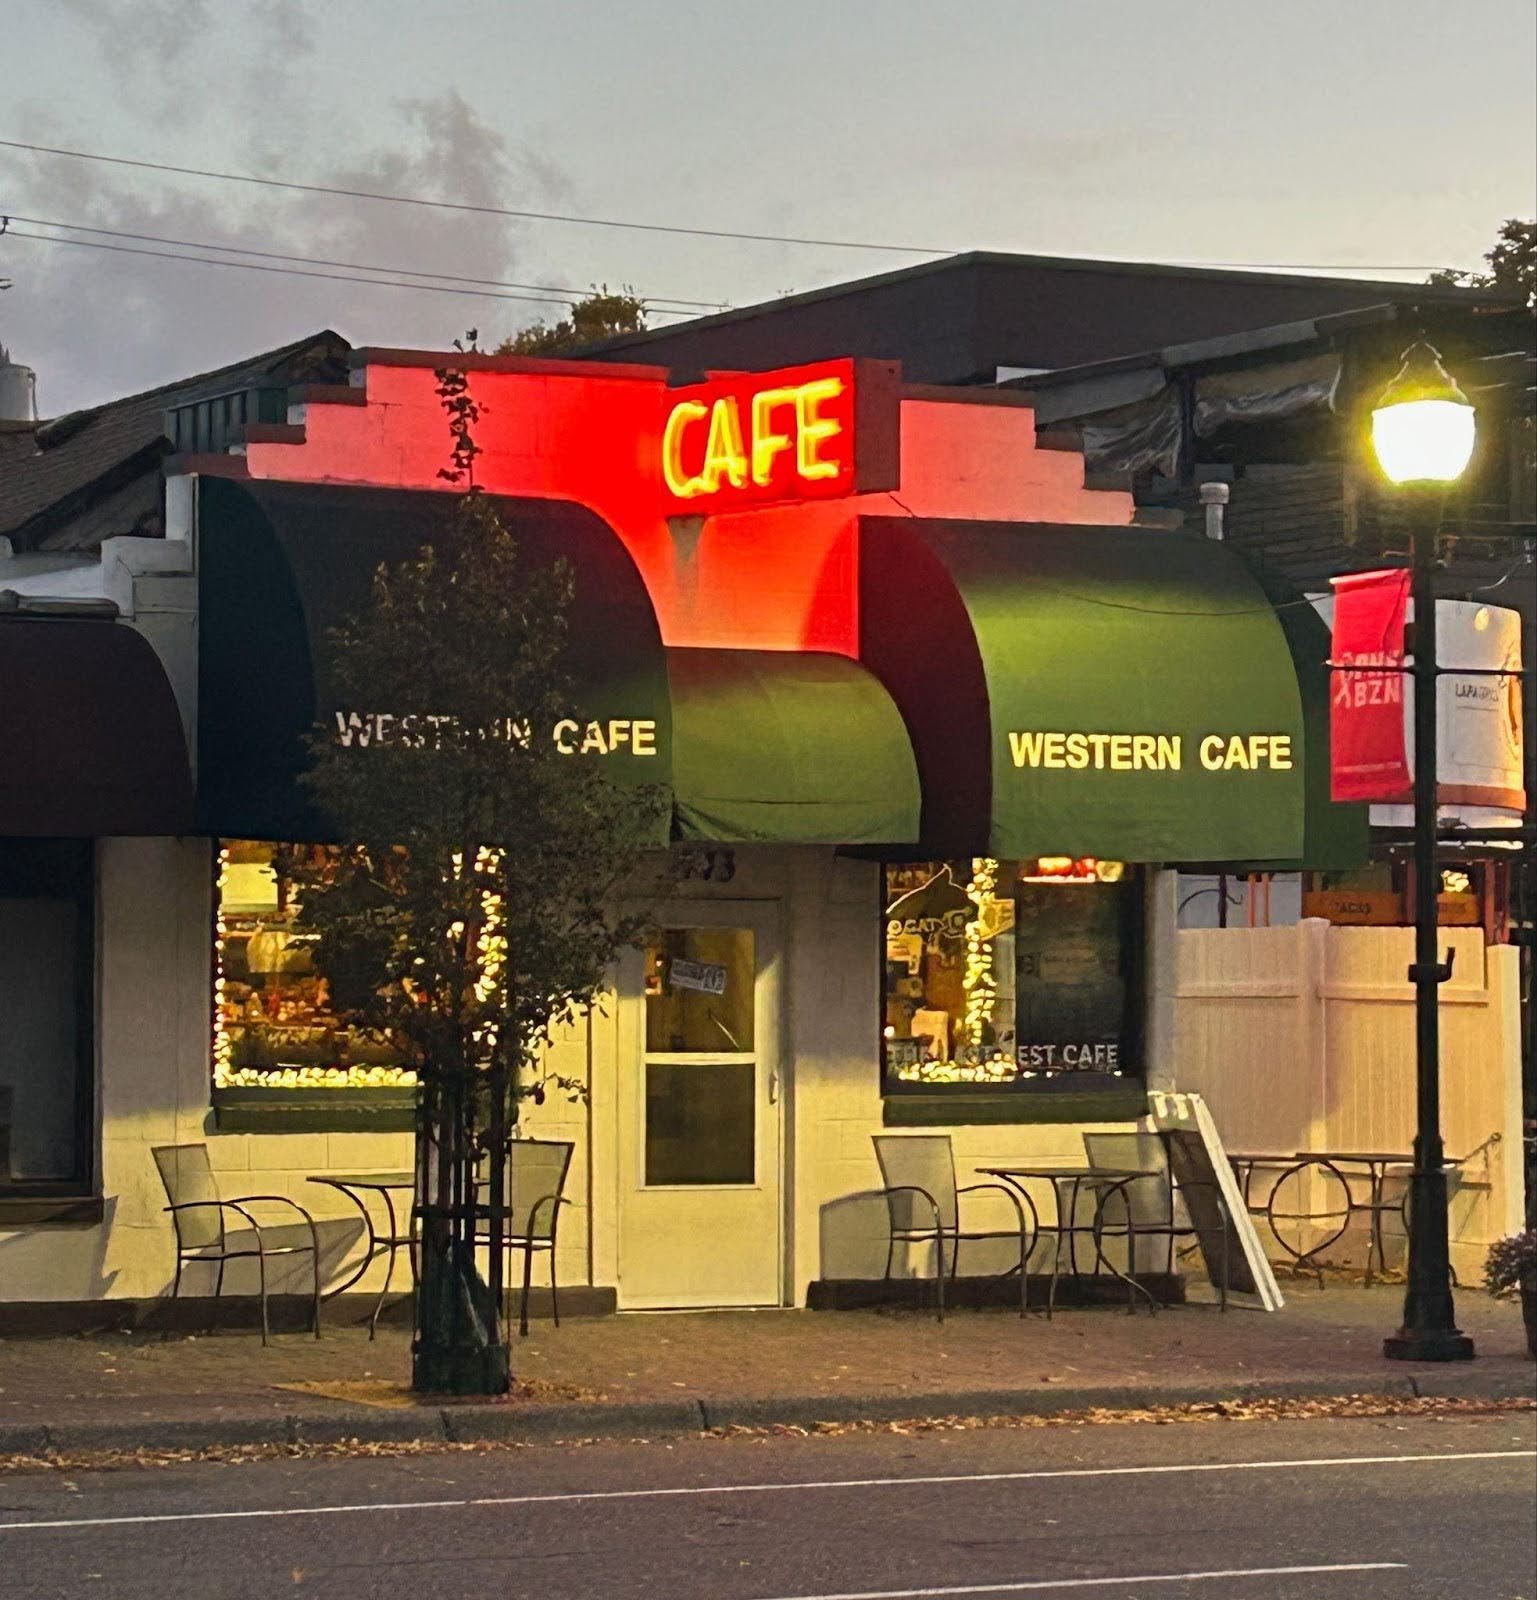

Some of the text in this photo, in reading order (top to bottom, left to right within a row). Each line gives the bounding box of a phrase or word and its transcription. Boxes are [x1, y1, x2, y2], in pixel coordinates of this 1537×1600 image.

[663, 376, 846, 499] CAFE
[336, 711, 656, 755] WESTN CAFE
[1008, 732, 1293, 771] WESTERN CAFE
[1063, 1044, 1118, 1065] CAFE
